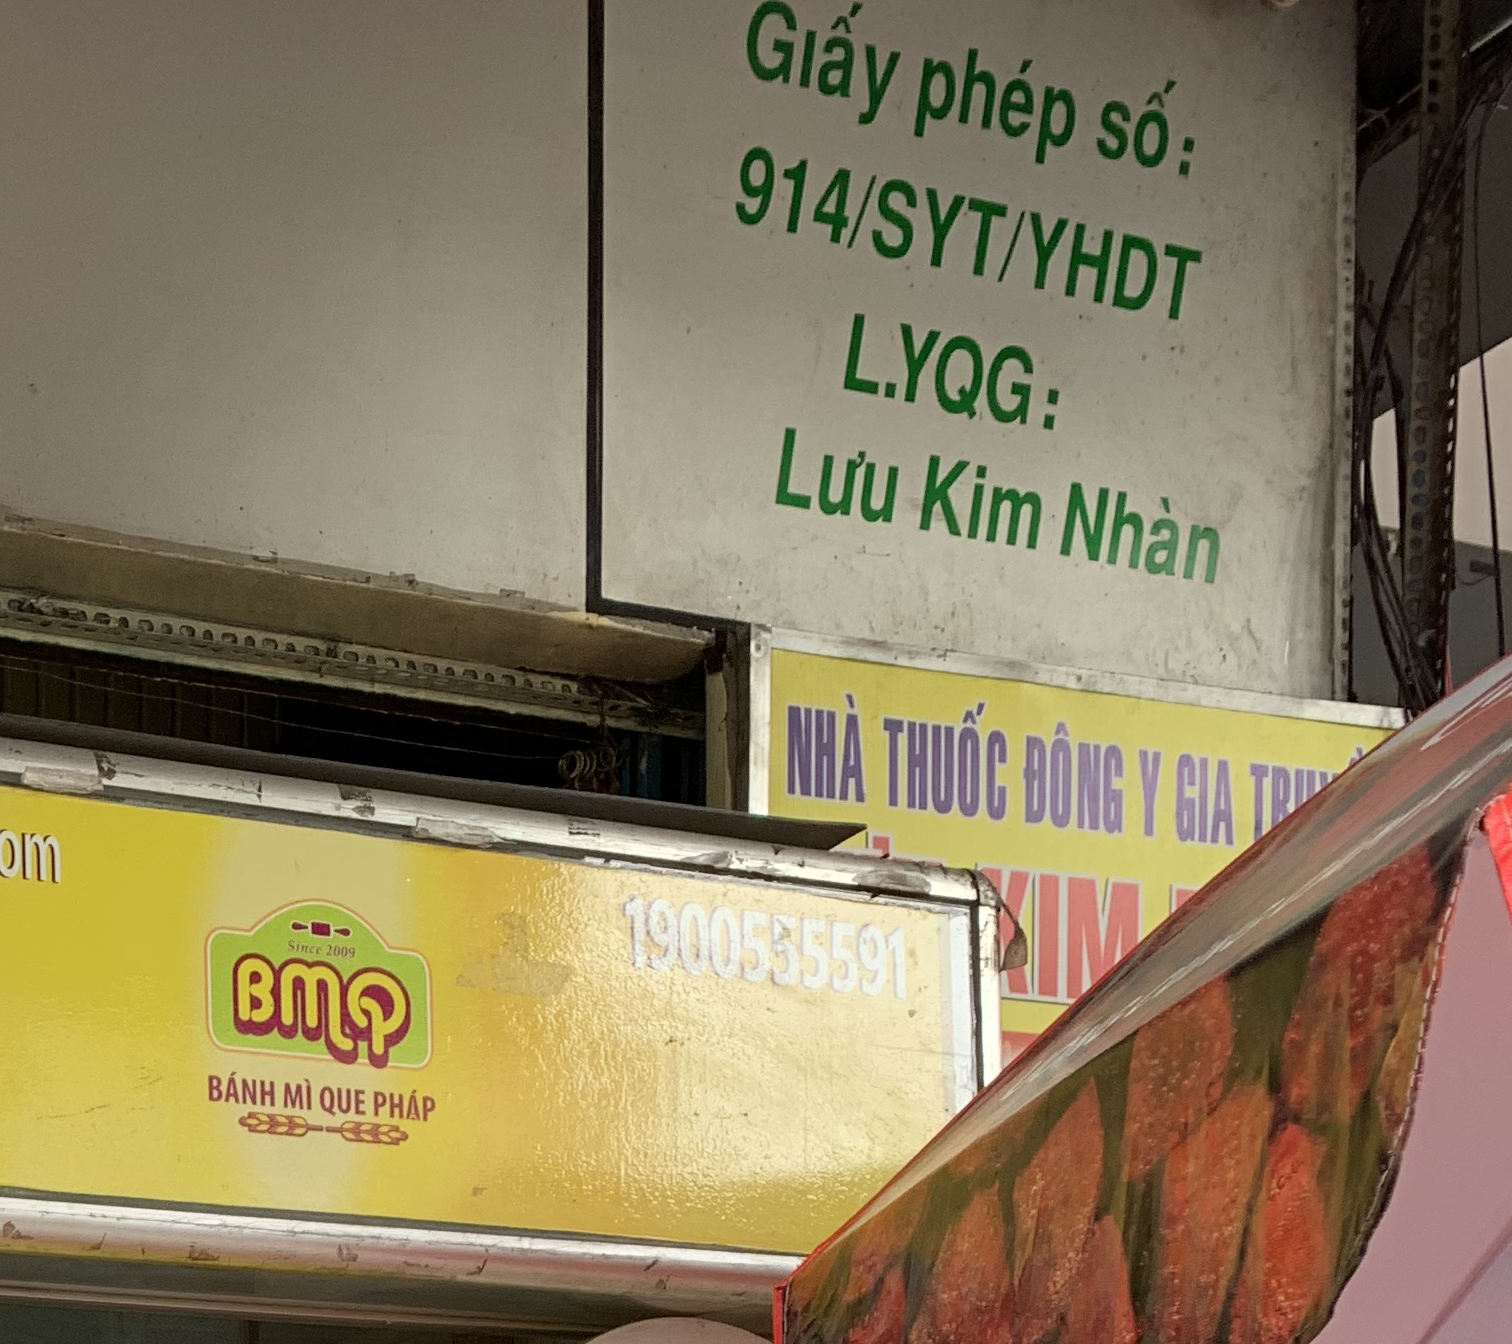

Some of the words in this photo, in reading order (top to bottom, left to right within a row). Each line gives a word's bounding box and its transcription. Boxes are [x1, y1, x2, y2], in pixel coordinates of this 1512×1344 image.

[745, 0, 901, 124] Giấy
[914, 48, 1076, 164] phép
[1096, 80, 1195, 177] số:
[734, 146, 1203, 322] 914/SYT/YHDT
[843, 312, 1059, 431] L.YQG:
[775, 426, 899, 523] Lưu
[920, 454, 1042, 550] Kim
[1061, 482, 1221, 584] Nhàn
[786, 693, 865, 803] NHÀ
[883, 701, 1008, 822] THUỐC
[1023, 721, 1123, 835] ĐÔNG
[1139, 749, 1162, 838] Y
[1175, 752, 1235, 846] GIA
[287, 938, 323, 958] Since
[326, 942, 356, 961] 2009
[621, 891, 909, 998] 1900555591
[981, 867, 1139, 1000] KIM
[232, 952, 411, 1069] BMQ
[207, 1072, 277, 1109] BÁNH
[282, 1077, 313, 1112] MÌ
[318, 1083, 367, 1117] QUE
[373, 1084, 436, 1124] PHÁP
